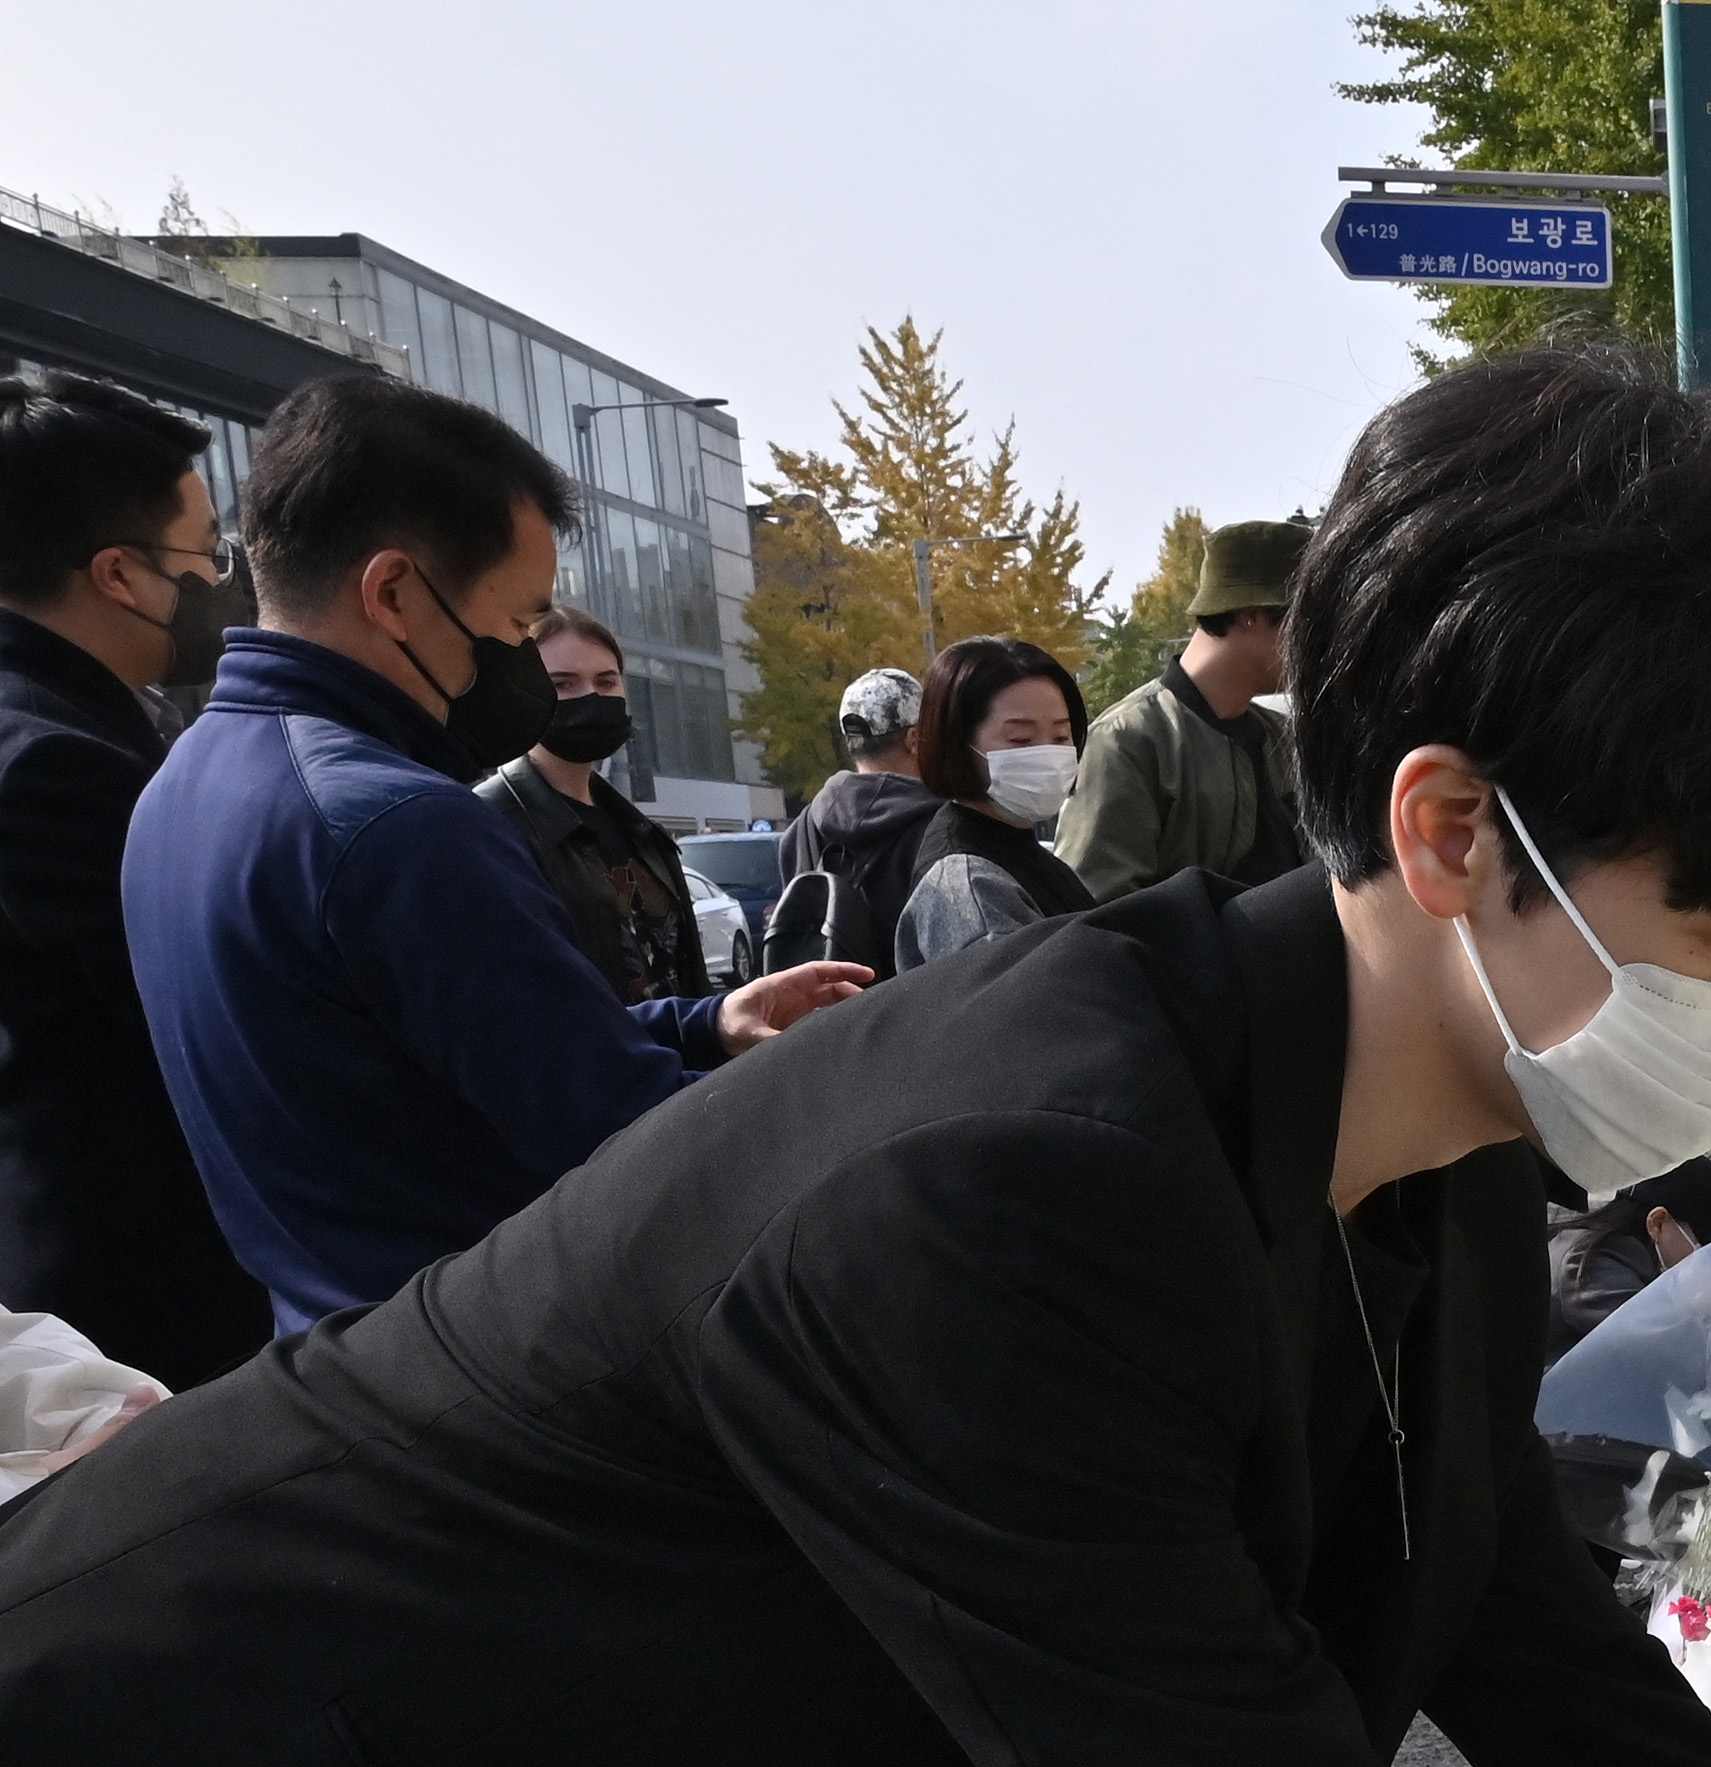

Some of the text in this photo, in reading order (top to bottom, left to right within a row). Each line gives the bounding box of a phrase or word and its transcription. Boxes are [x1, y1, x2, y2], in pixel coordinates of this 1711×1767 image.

[1506, 216, 1599, 249] 보광로
[1399, 253, 1457, 275] 普光路
[1472, 253, 1600, 280] Bogwang-ro
